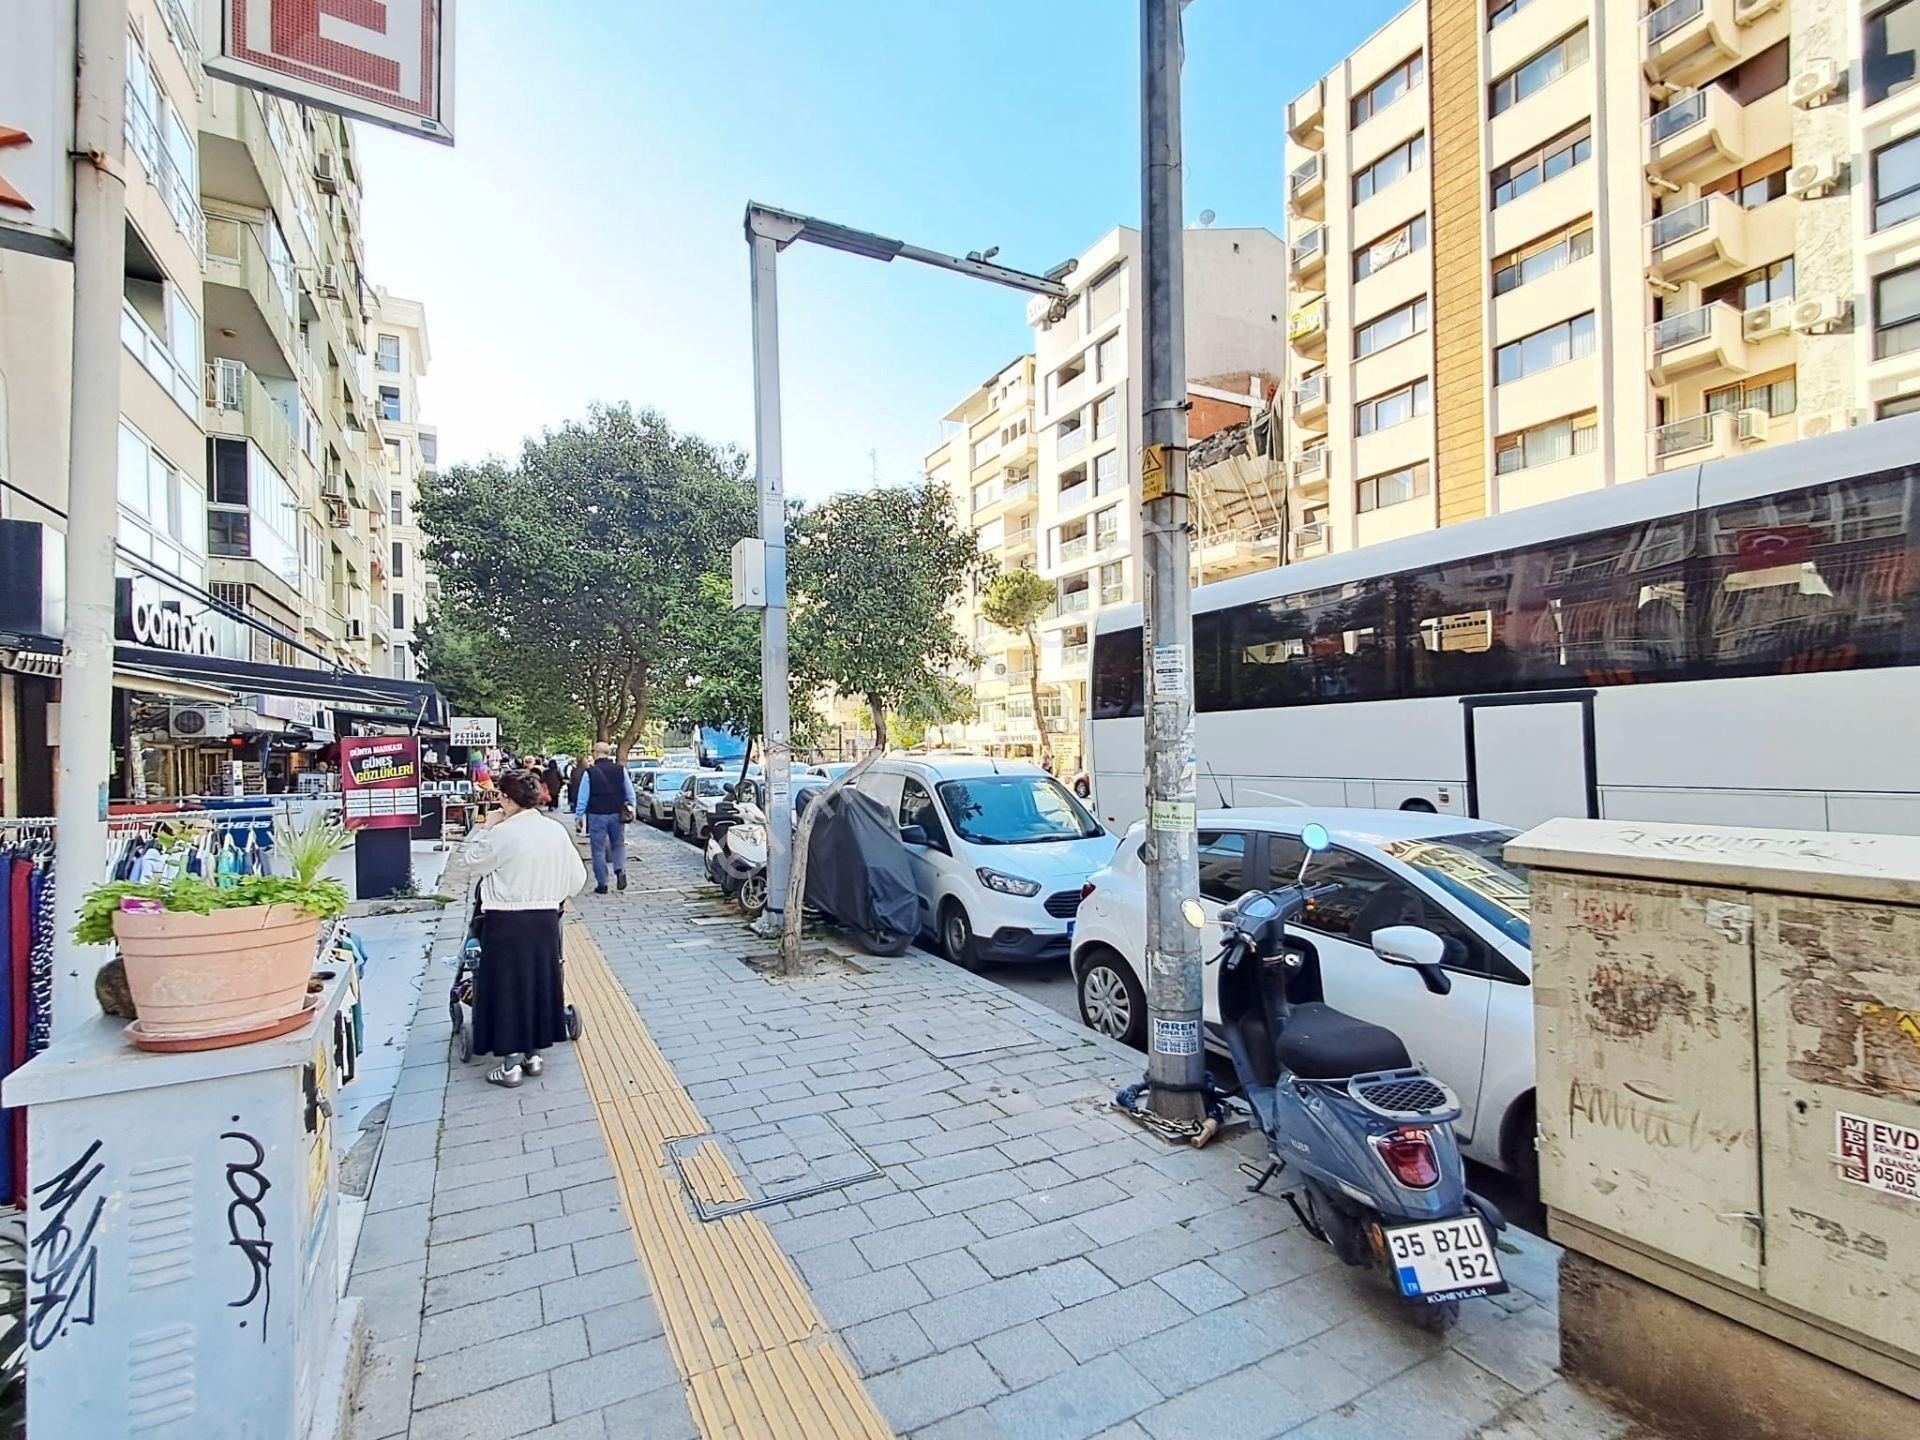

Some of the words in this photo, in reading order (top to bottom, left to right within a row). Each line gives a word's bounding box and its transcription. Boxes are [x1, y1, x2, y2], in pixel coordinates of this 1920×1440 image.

[350, 746, 372, 757] DÜNYA
[373, 743, 403, 754] MARKASI
[362, 755, 393, 769] GÜNEŞ
[356, 762, 414, 782] GÖZLÜKLERİ
[1156, 1020, 1196, 1030] YAREN
[1874, 1165, 1916, 1188] 0505
[1393, 1232, 1426, 1259] 35
[1432, 1224, 1483, 1253] BZU
[1445, 1253, 1494, 1282] 152
[1407, 1282, 1419, 1292] TR
